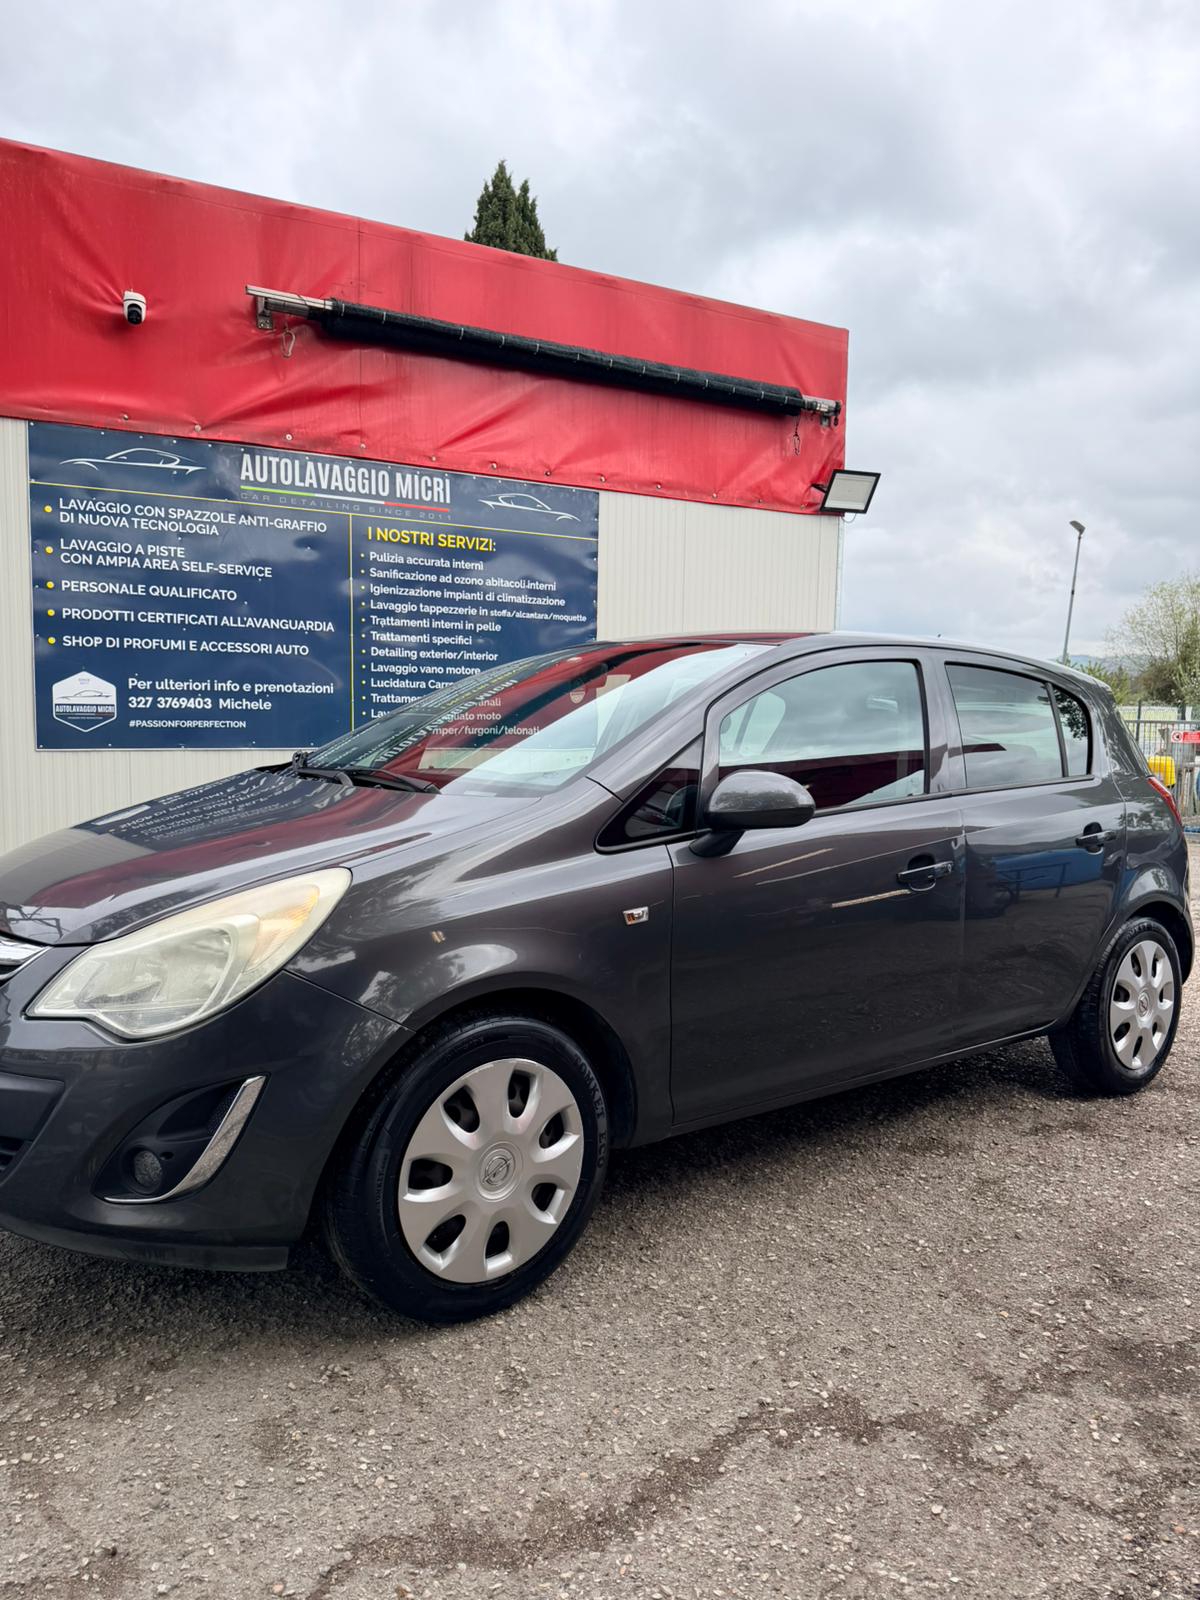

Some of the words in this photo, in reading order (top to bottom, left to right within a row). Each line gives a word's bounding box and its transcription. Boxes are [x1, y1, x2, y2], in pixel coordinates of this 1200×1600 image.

[240, 454, 390, 497] AUTOLAVAGGIO
[396, 472, 451, 504] MICRI
[59, 498, 130, 515] LAVAGGIO
[134, 505, 164, 518] CON
[168, 508, 236, 525] SPAZZOLE
[238, 516, 327, 533] ANTI-GRAFFIO
[240, 492, 270, 502] CAR
[279, 496, 361, 512] DETAILING
[369, 506, 412, 518] SINCE
[420, 512, 452, 520] 2011
[60, 512, 74, 524] DI
[78, 513, 129, 529] NUOVA
[130, 518, 219, 536] TECNOLOGIA
[60, 538, 132, 554] LAVAGGIO
[134, 543, 145, 556] A
[148, 544, 186, 558] PISTE
[368, 527, 372, 540] I
[375, 528, 434, 546] NOSTRI
[438, 534, 496, 552] SERVIZI:
[60, 553, 92, 566] CON
[96, 556, 142, 569] AMPIA
[143, 558, 180, 571] AREA
[182, 560, 272, 578] SELF-SERVICE
[369, 552, 404, 564] Pulizia
[406, 556, 450, 568] accurata
[452, 558, 484, 570] interni
[370, 568, 437, 582] Sanificazione
[439, 572, 452, 583] ad
[454, 576, 484, 586] ozono
[486, 576, 527, 590] abitacoli
[528, 580, 556, 591] interni
[62, 580, 146, 597] PERSONALE
[149, 585, 238, 602] QUALIFICATO
[370, 584, 442, 598] Igienizzazione
[444, 588, 484, 602] impianti
[486, 592, 495, 602] di
[497, 592, 566, 606] climatizzazione
[62, 608, 134, 622] PRODOTTI
[138, 612, 218, 626] CERTIFICATI
[220, 616, 334, 632] ALL'AVANGUARDIA
[370, 600, 418, 614] Lavaggio
[419, 604, 478, 617] tappezzerie
[479, 607, 488, 616] in
[490, 610, 587, 623] stoffa/alcantara/moquette
[370, 616, 430, 629] Trattamenti
[432, 620, 464, 631] interni
[465, 621, 474, 631] in
[476, 622, 502, 633] pelle
[62, 636, 102, 648] SHOP
[106, 637, 120, 649] DI
[123, 638, 186, 651] PROFUMI
[189, 640, 198, 652] E
[200, 641, 272, 655] ACCESSORI
[275, 644, 310, 656] AUTO
[370, 632, 430, 644] Trattamenti
[432, 634, 472, 646] specifici
[371, 647, 417, 660] Detailing
[419, 650, 498, 662] exterior/interior
[371, 663, 418, 676] Lavaggio
[419, 667, 444, 675] vano
[446, 667, 481, 676] motore
[128, 678, 152, 690] Per
[155, 678, 211, 692] ulteriori
[214, 679, 240, 692] info
[242, 684, 252, 692] e
[254, 682, 334, 696] prenotazioni
[371, 678, 426, 689] Lucidatura
[128, 697, 152, 708] 327
[156, 698, 212, 710] 3769403
[219, 698, 272, 710] Michele
[129, 720, 246, 729] #PASSIONFORPERFECTION
[432, 726, 540, 736] mper/furgoni/telonati
